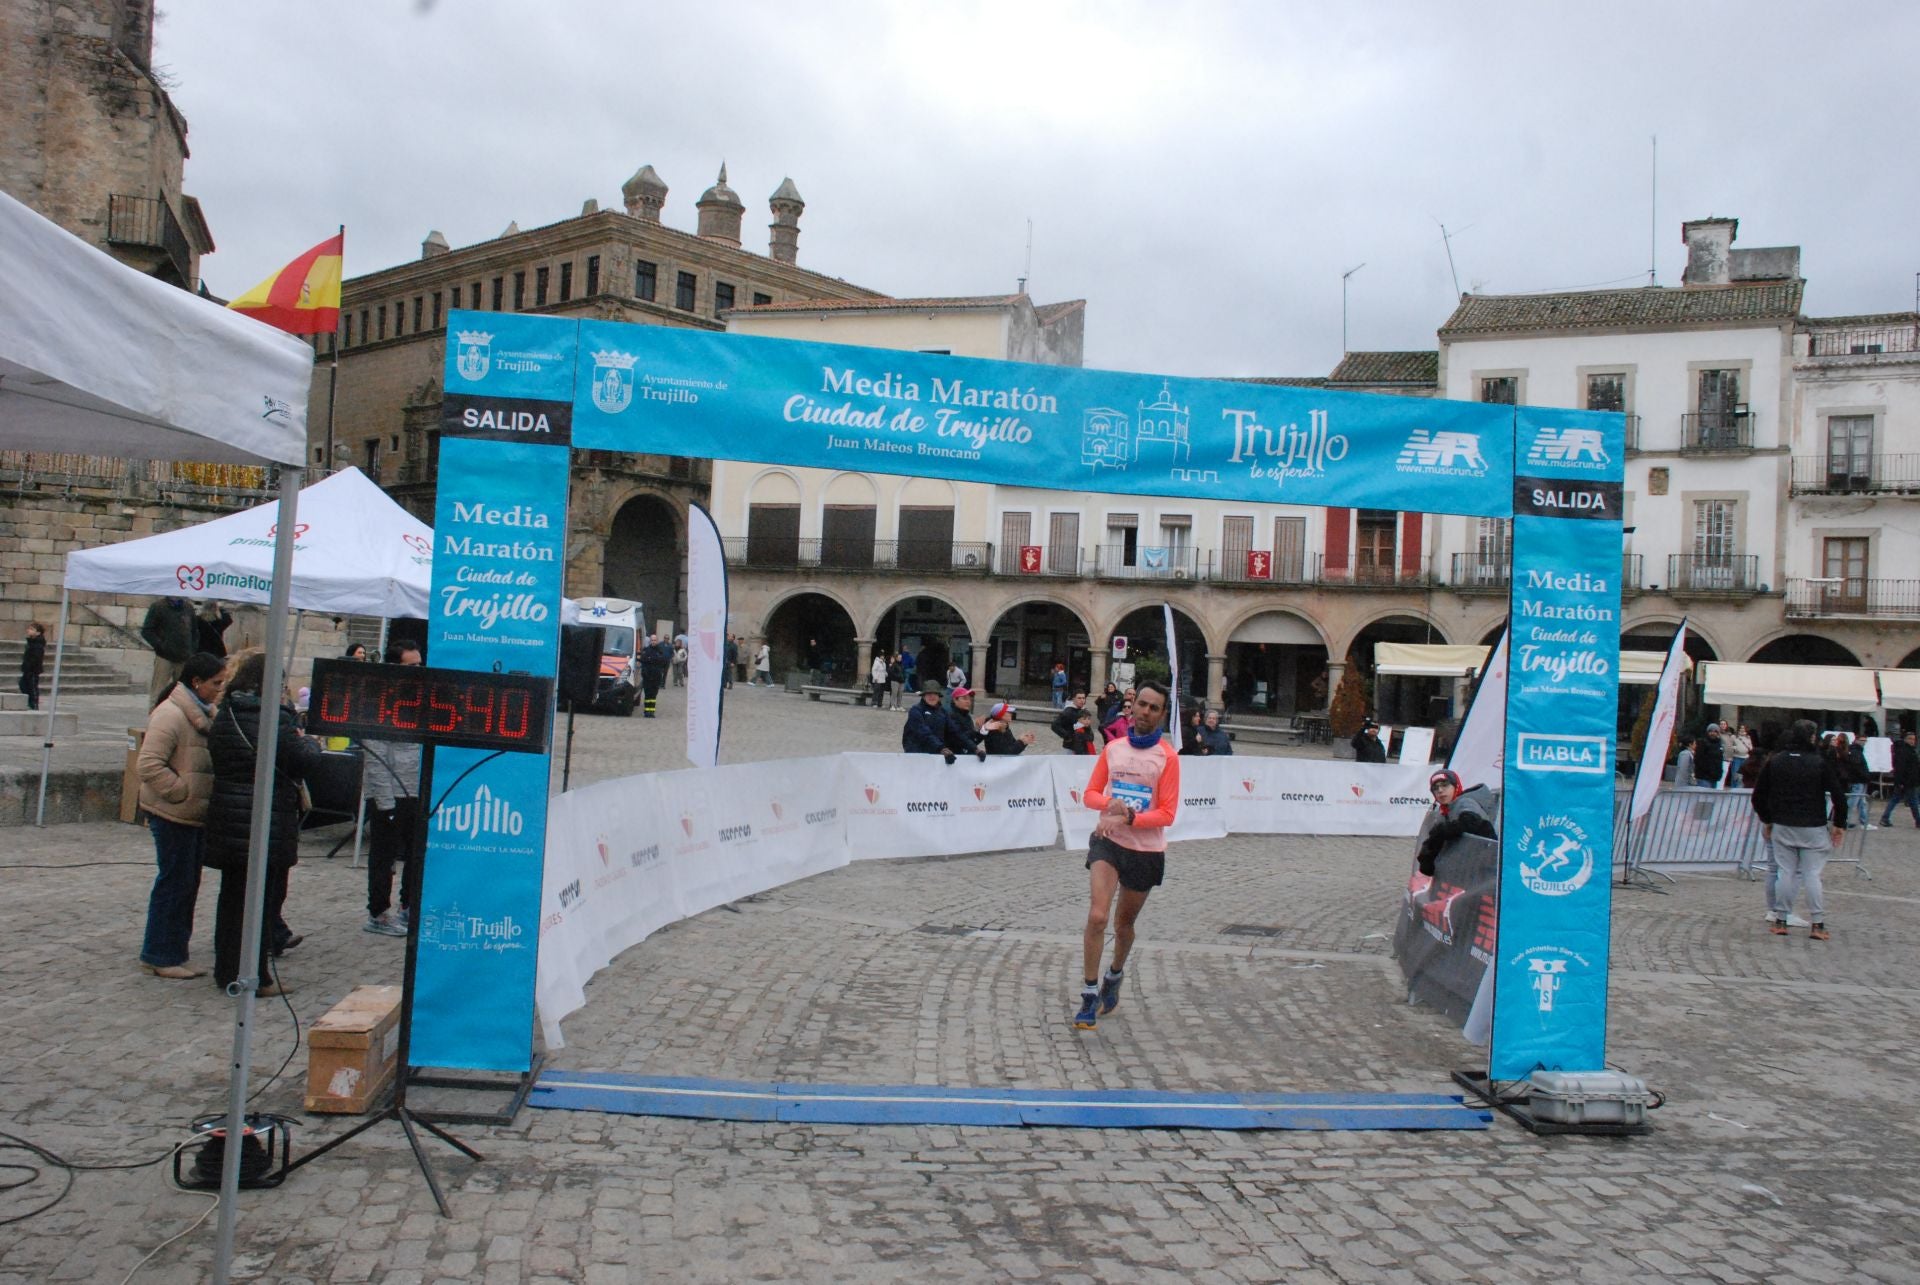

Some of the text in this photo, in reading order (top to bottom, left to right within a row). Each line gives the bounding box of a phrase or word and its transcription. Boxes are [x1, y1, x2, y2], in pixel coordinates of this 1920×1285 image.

[496, 358, 541, 374] Trujillo
[643, 373, 728, 391] Ayuntamiento de
[820, 366, 1058, 414] Media Maratón
[641, 386, 699, 405] Trujillo
[463, 408, 550, 433] SALIDA
[783, 394, 1032, 449] Ciudad de Trujillo
[827, 434, 980, 460] Juan Mateos Broncano
[1222, 407, 1349, 472] Trujillo
[1249, 459, 1264, 479] te
[1396, 464, 1485, 477] www.musicrun.es
[1527, 457, 1606, 470] www.musicrun.es
[1532, 488, 1605, 510] SALIDA
[453, 501, 549, 529] Media
[444, 535, 554, 561] Maratón
[206, 571, 274, 594] primaflor
[457, 565, 538, 586] Ciudad de
[1527, 570, 1607, 592] Media
[441, 586, 548, 630] Trujillo
[1521, 599, 1613, 621] Maratón
[443, 631, 544, 647] Juan Mateos Broncano
[1531, 626, 1598, 644] Ciudad de
[1519, 644, 1609, 682] Trujillo
[1530, 744, 1593, 762] HABLA
[436, 784, 523, 840] trujillo
[1517, 825, 1534, 851] Club
[1538, 813, 1588, 841] Atletismo
[467, 916, 522, 940] Trujillo
[1543, 990, 1550, 1003] S
